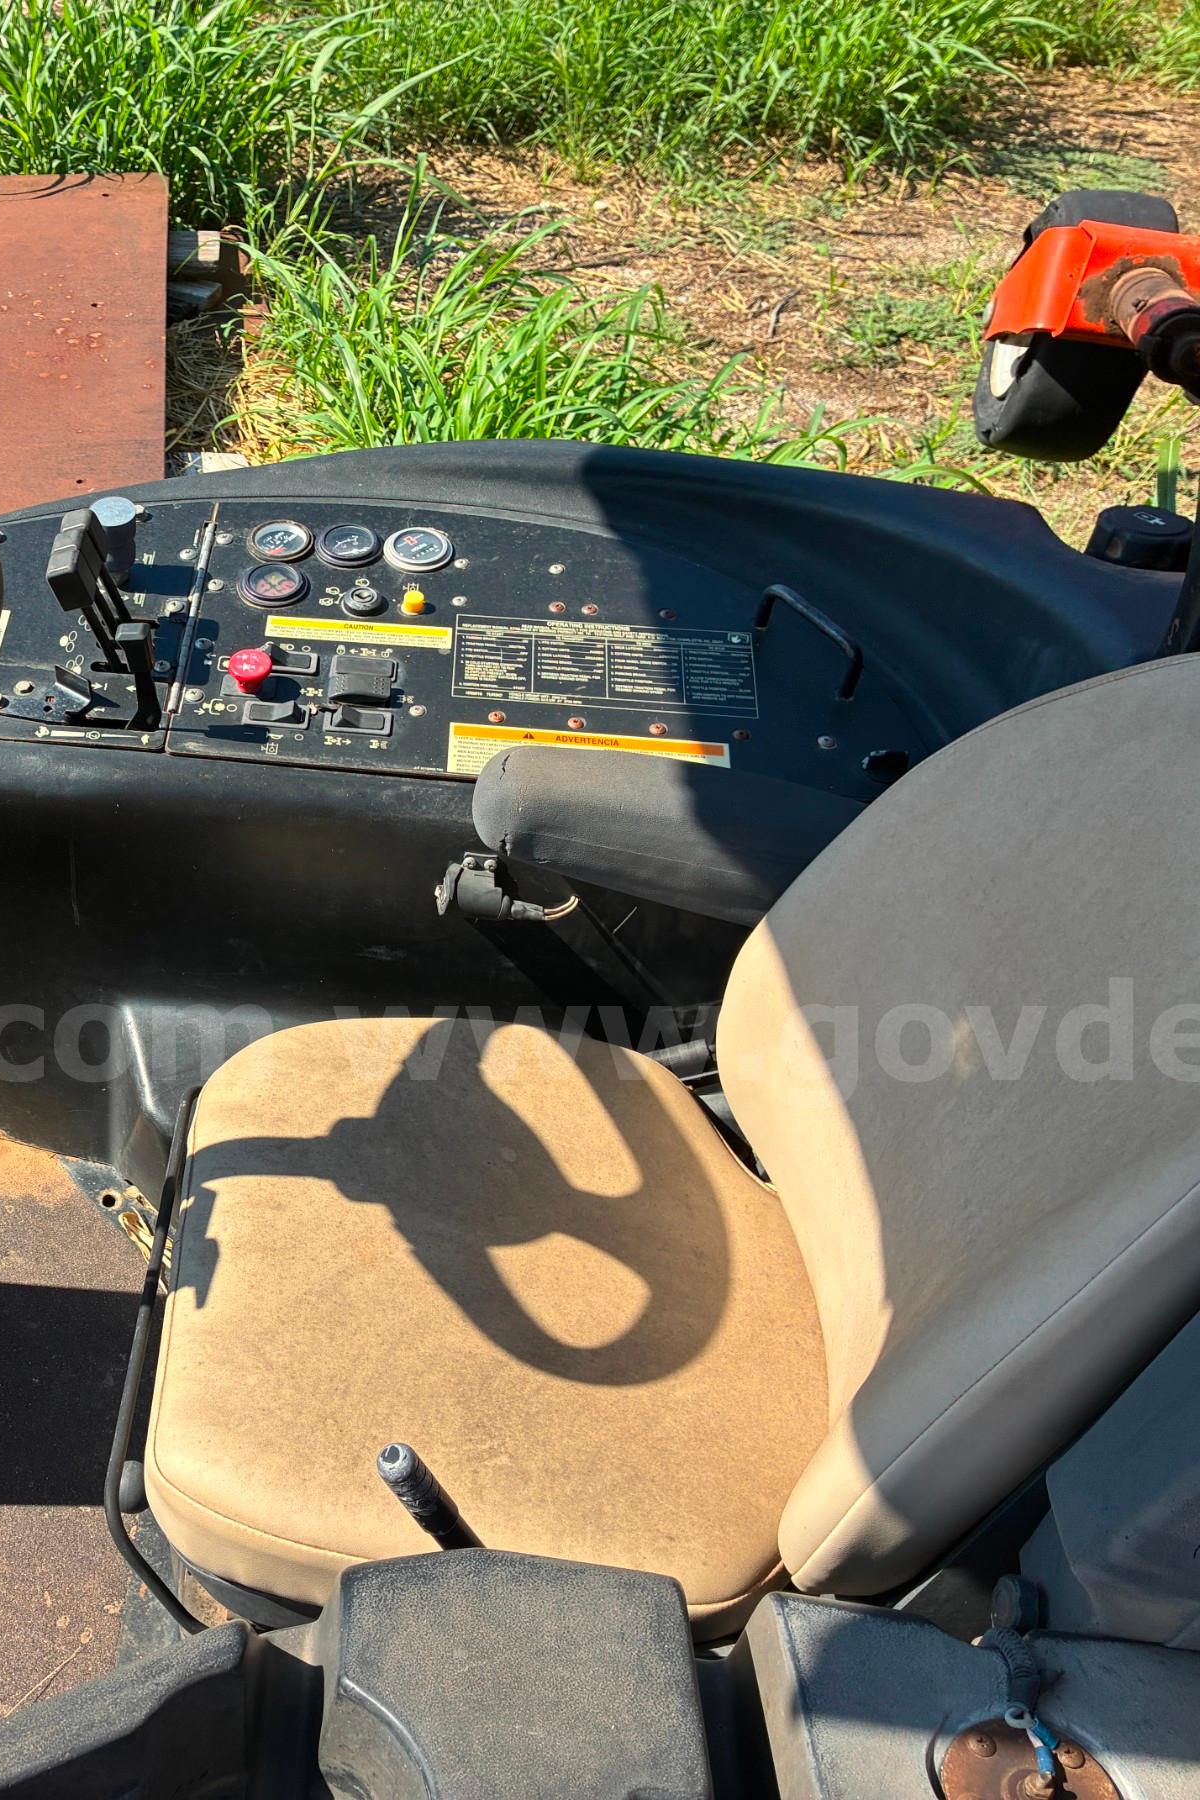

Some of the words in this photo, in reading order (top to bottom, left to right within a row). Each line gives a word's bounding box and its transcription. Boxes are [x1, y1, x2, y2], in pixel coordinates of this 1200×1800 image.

[546, 620, 582, 629] OPERATING
[583, 623, 629, 632] INSTRUCTIONS
[555, 735, 619, 747] ADVERTENCIA
